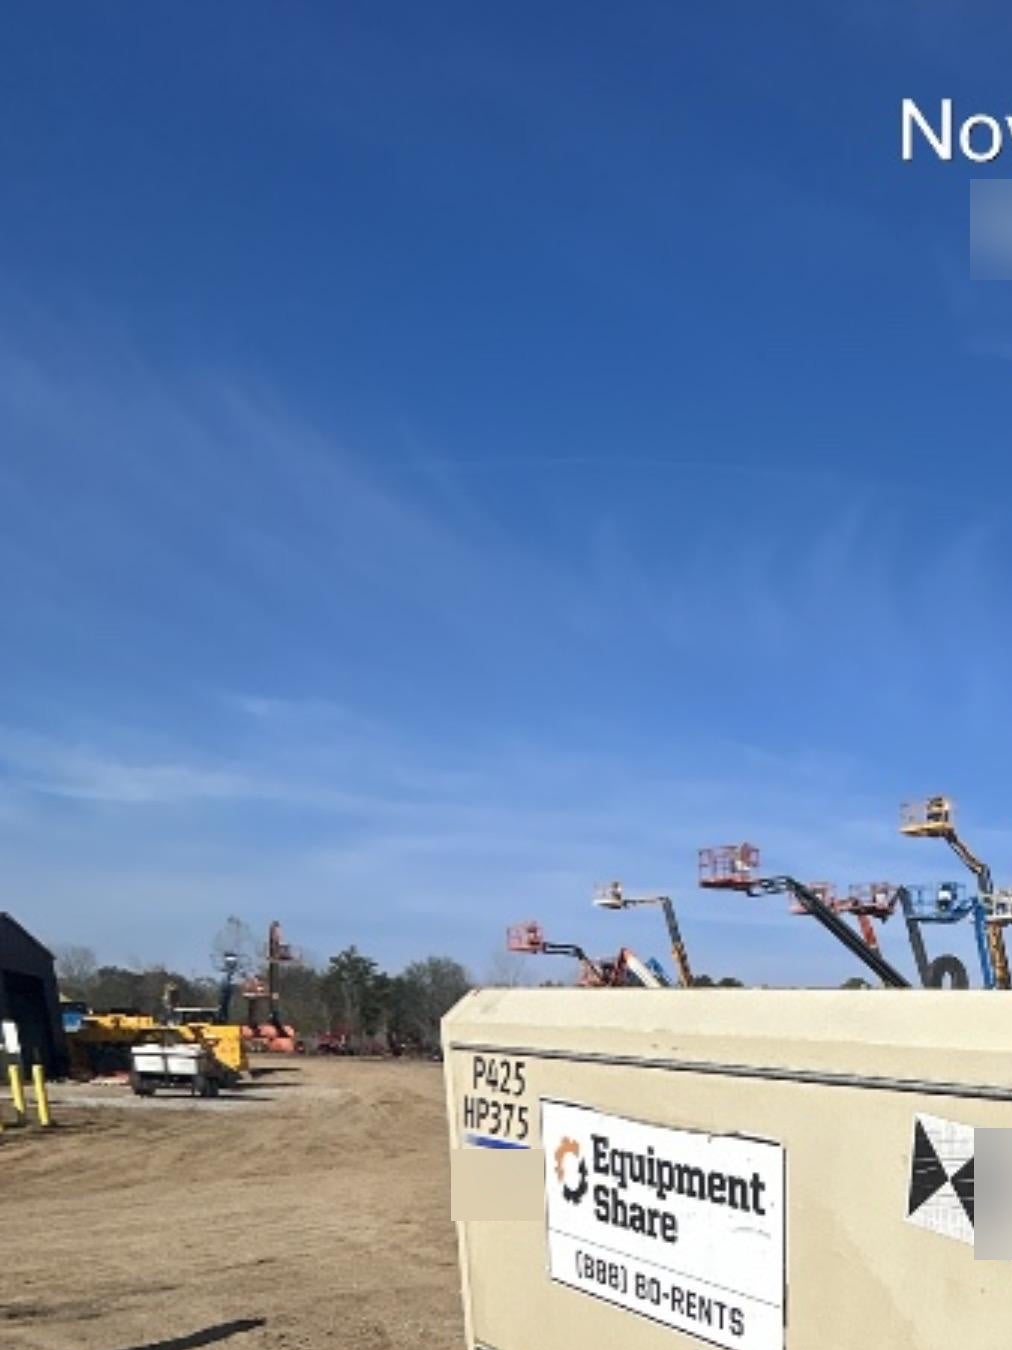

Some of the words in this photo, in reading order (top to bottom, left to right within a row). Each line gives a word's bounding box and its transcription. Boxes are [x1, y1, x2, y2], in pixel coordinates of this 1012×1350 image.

[473, 1056, 525, 1096] P425
[463, 1095, 529, 1140] HP375
[590, 1133, 766, 1216] Equipment
[593, 1184, 679, 1244] Share
